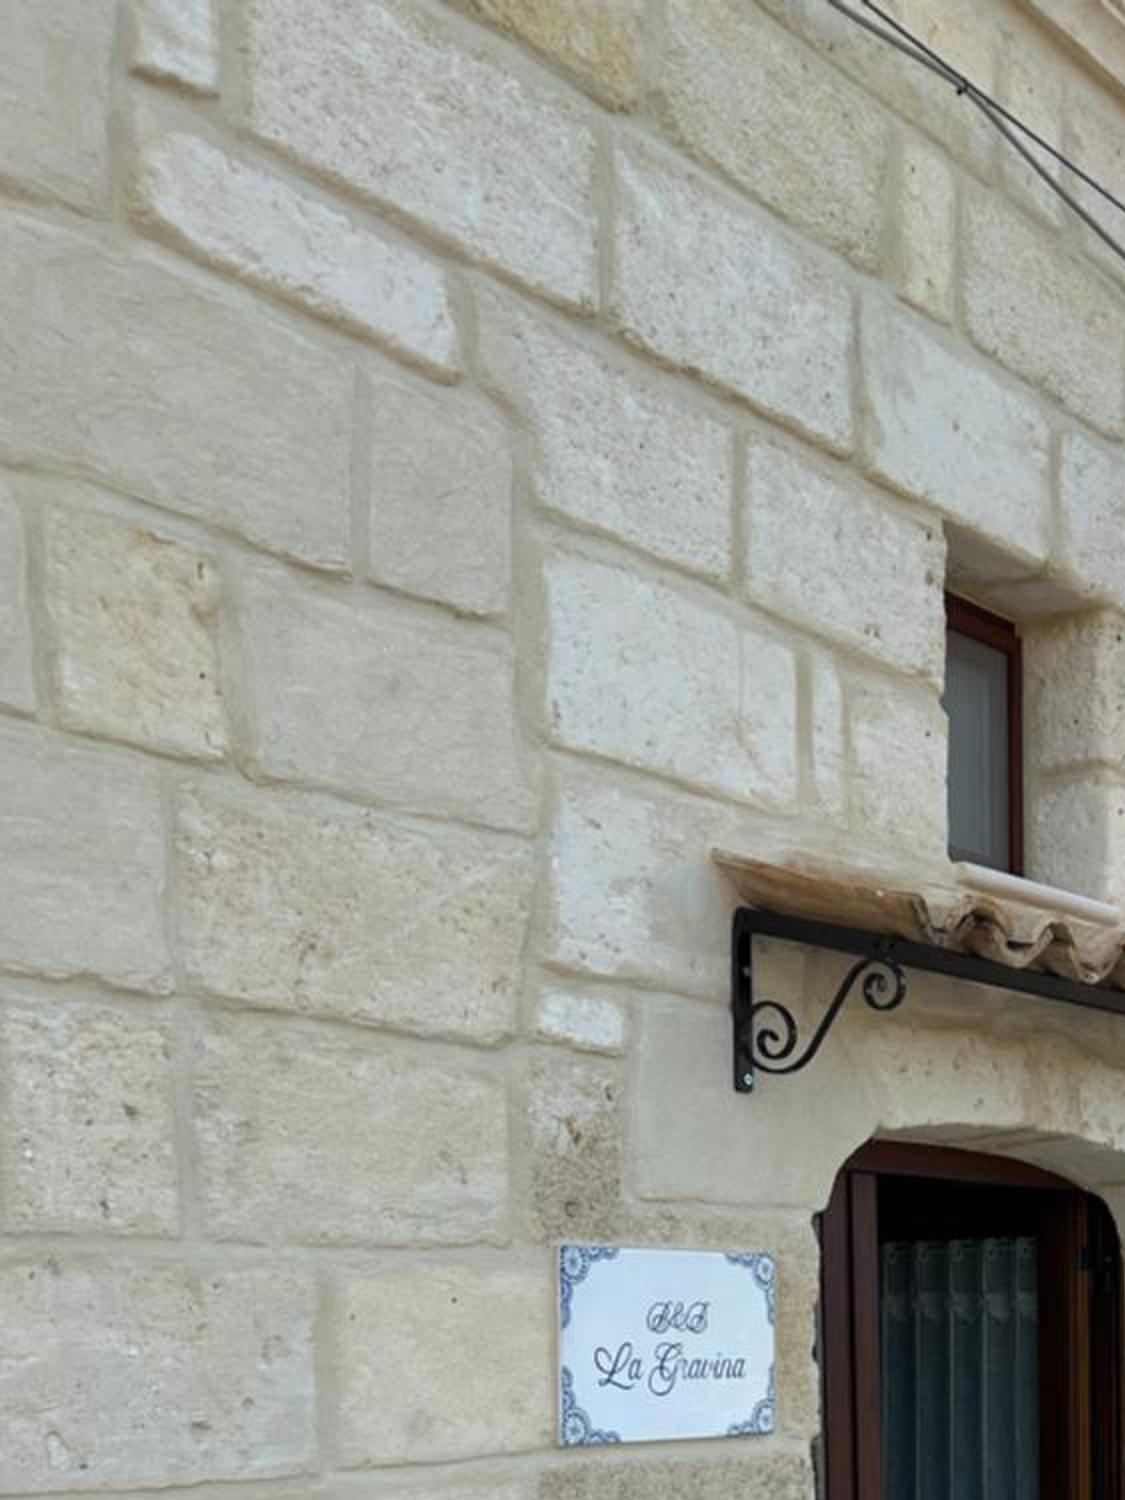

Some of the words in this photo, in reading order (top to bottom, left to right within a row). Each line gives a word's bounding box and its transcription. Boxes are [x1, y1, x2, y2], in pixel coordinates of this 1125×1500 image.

[646, 1300, 710, 1334] B&B
[594, 1342, 642, 1390] La
[648, 1342, 746, 1396] Gravina
